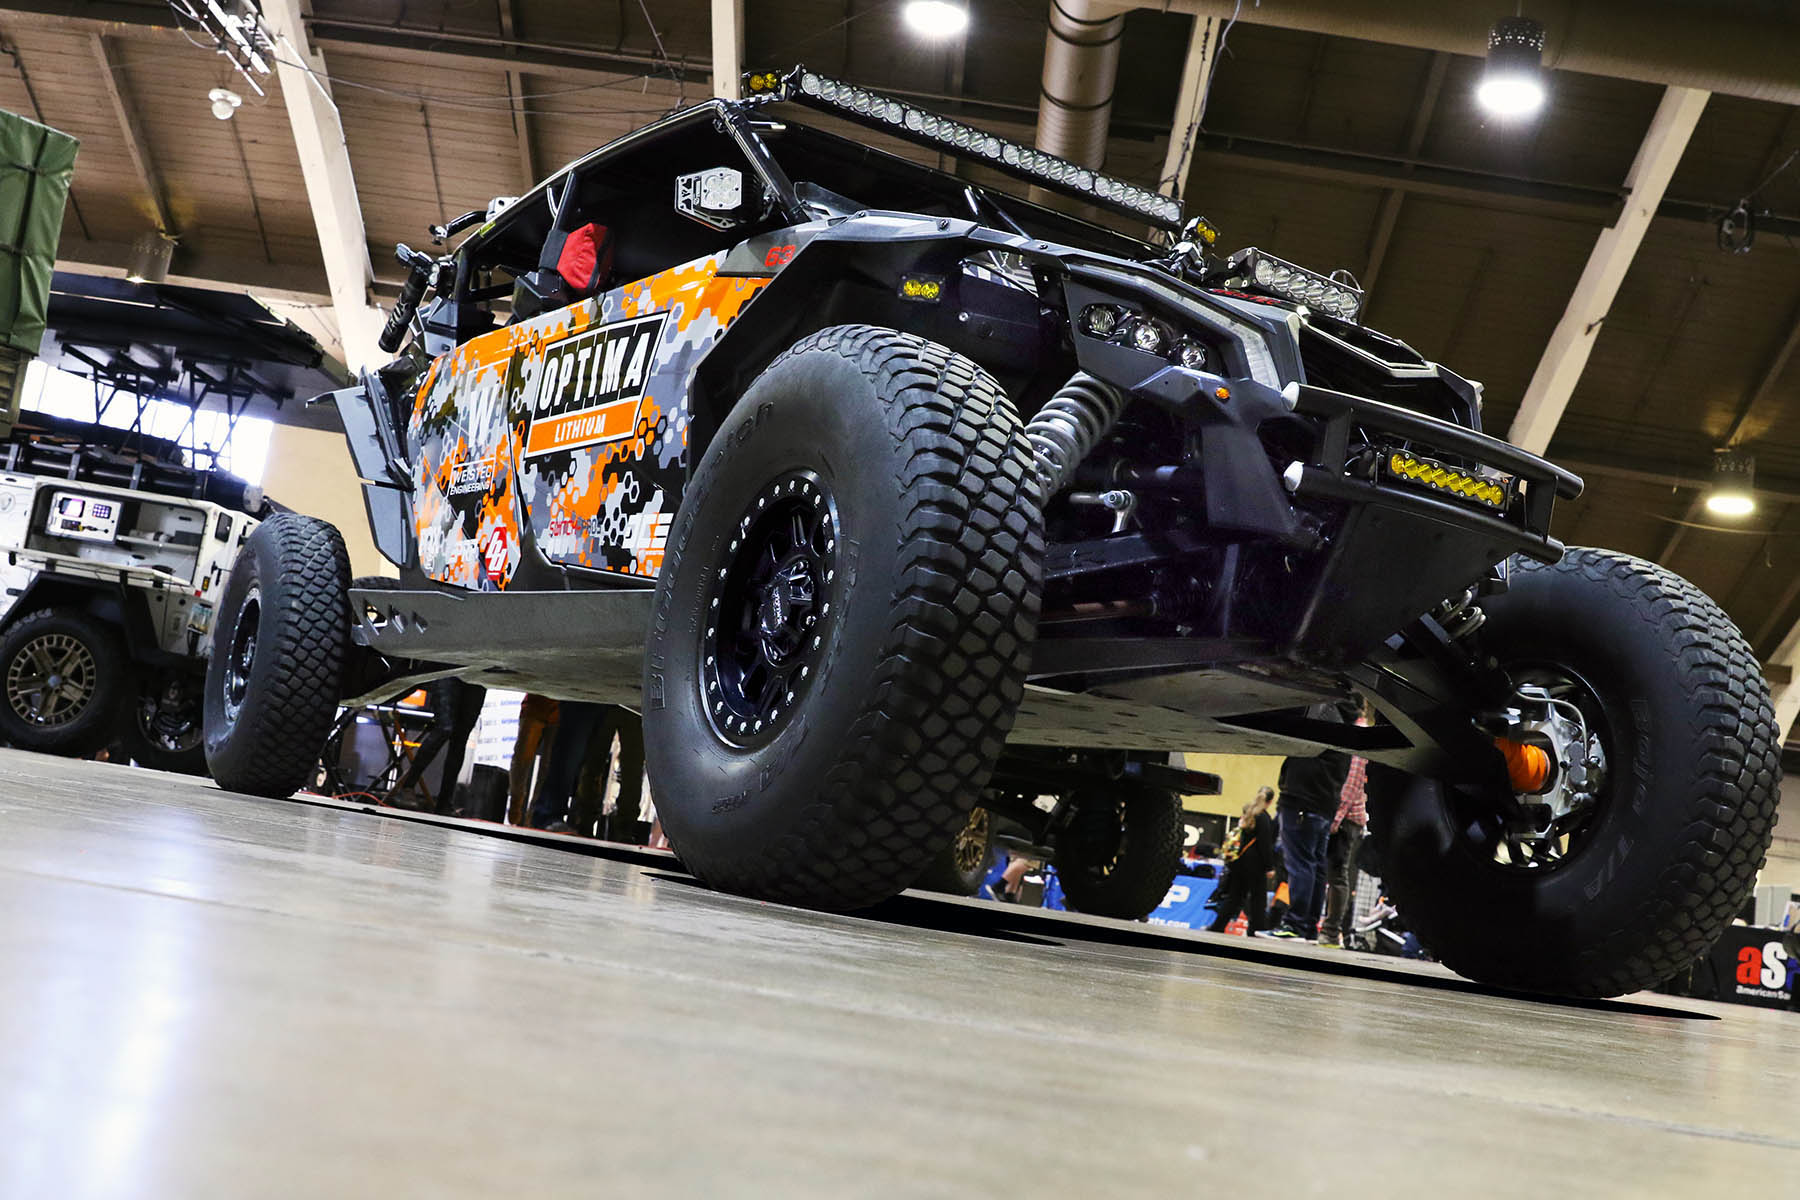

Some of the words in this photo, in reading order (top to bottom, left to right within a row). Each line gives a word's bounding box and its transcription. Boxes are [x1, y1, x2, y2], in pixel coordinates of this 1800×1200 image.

[765, 244, 796, 268] 63
[540, 332, 651, 411] OPTIMA
[554, 414, 607, 443] LITHIUM
[450, 481, 491, 495] ENGINEERING
